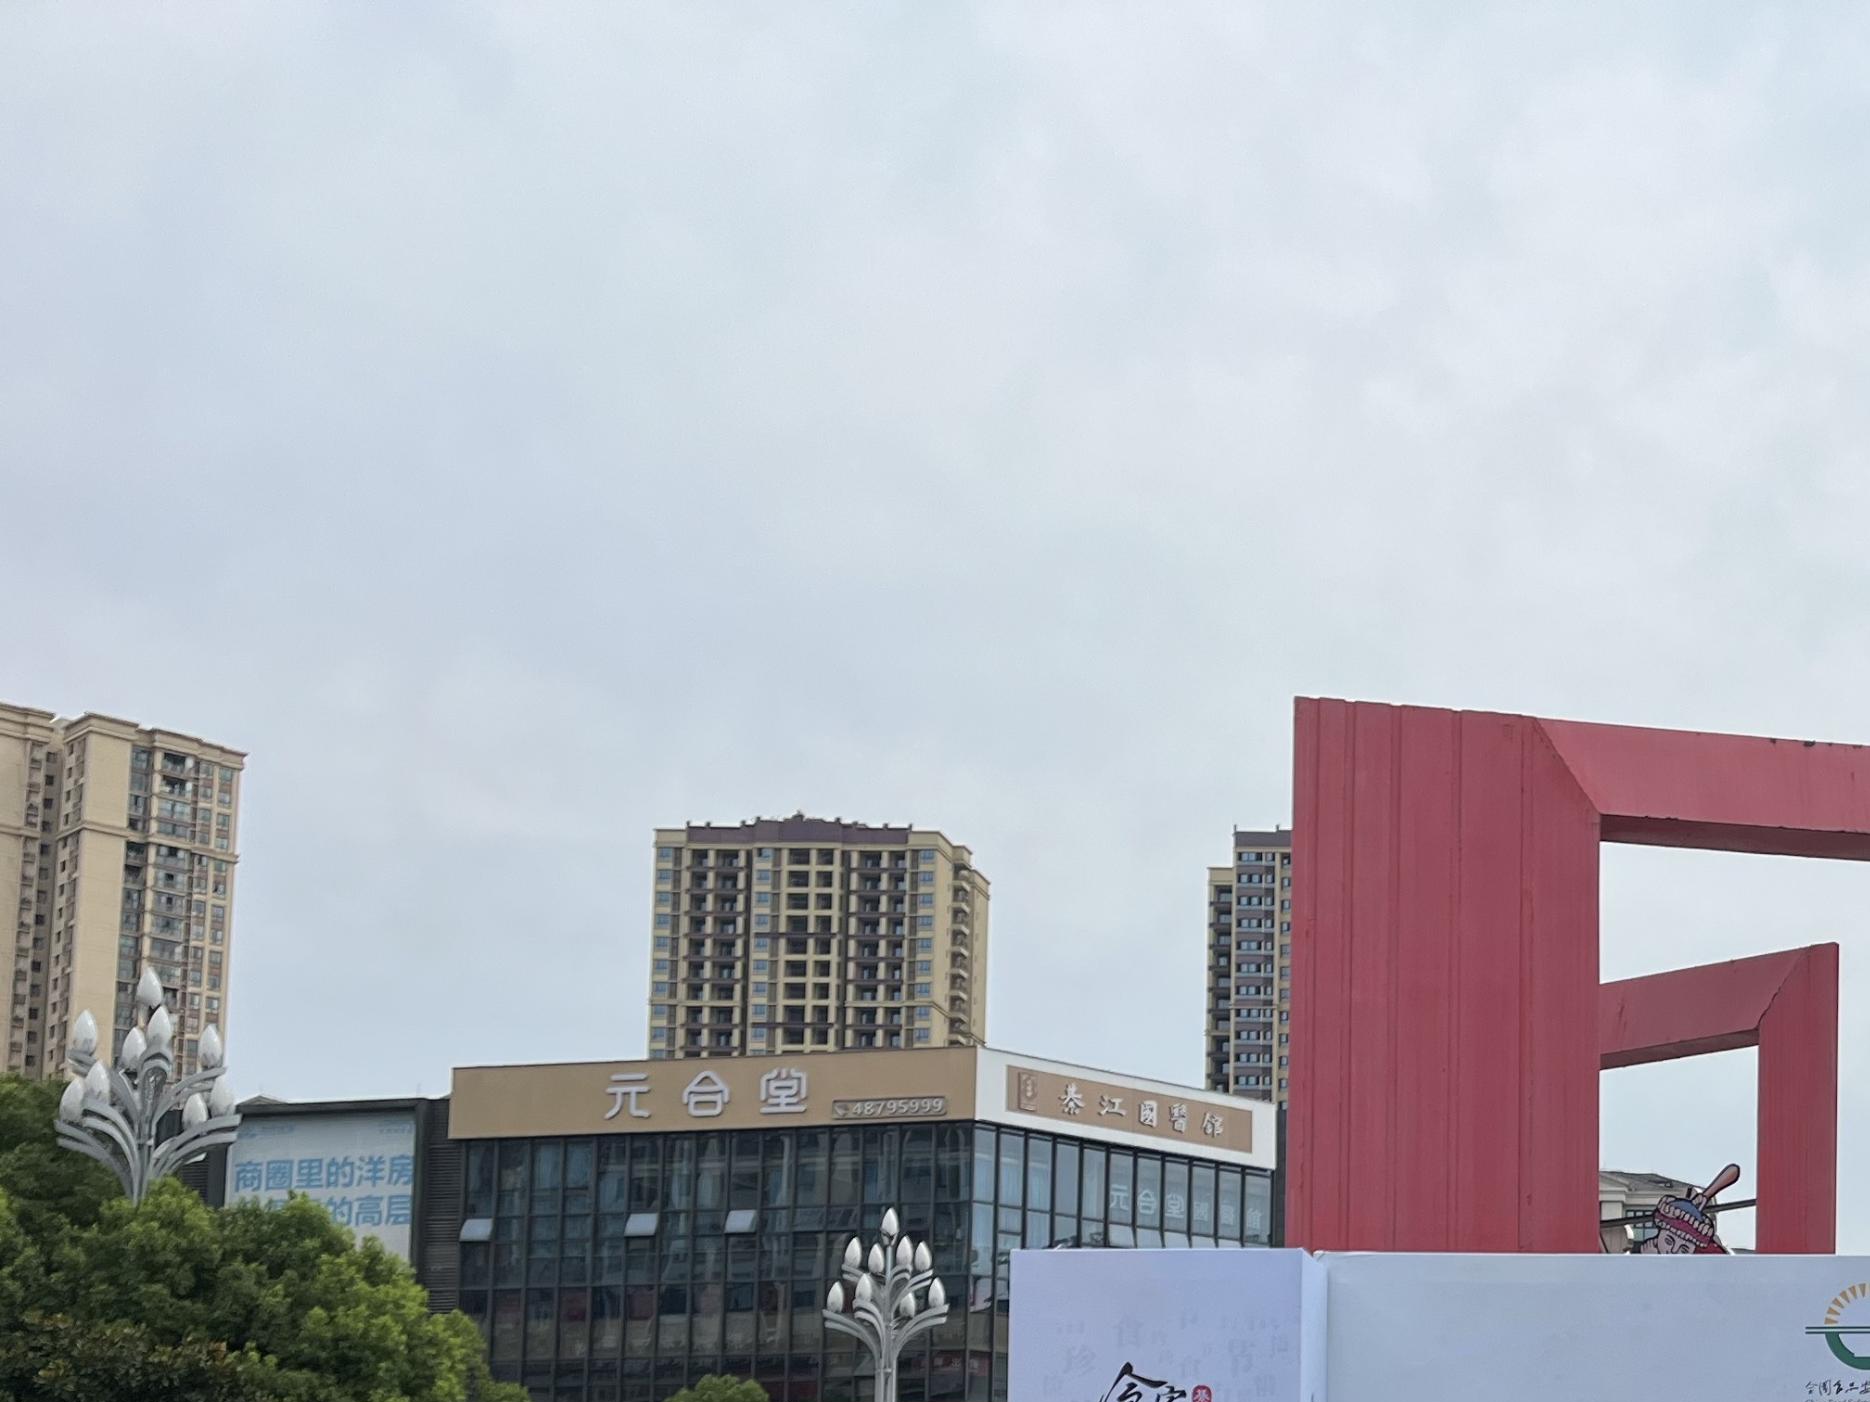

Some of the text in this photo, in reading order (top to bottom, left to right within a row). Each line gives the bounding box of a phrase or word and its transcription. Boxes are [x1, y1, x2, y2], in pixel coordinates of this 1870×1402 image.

[604, 1068, 944, 1120] 元合堂 48795999
[234, 1154, 414, 1193] 商圈里的洋房
